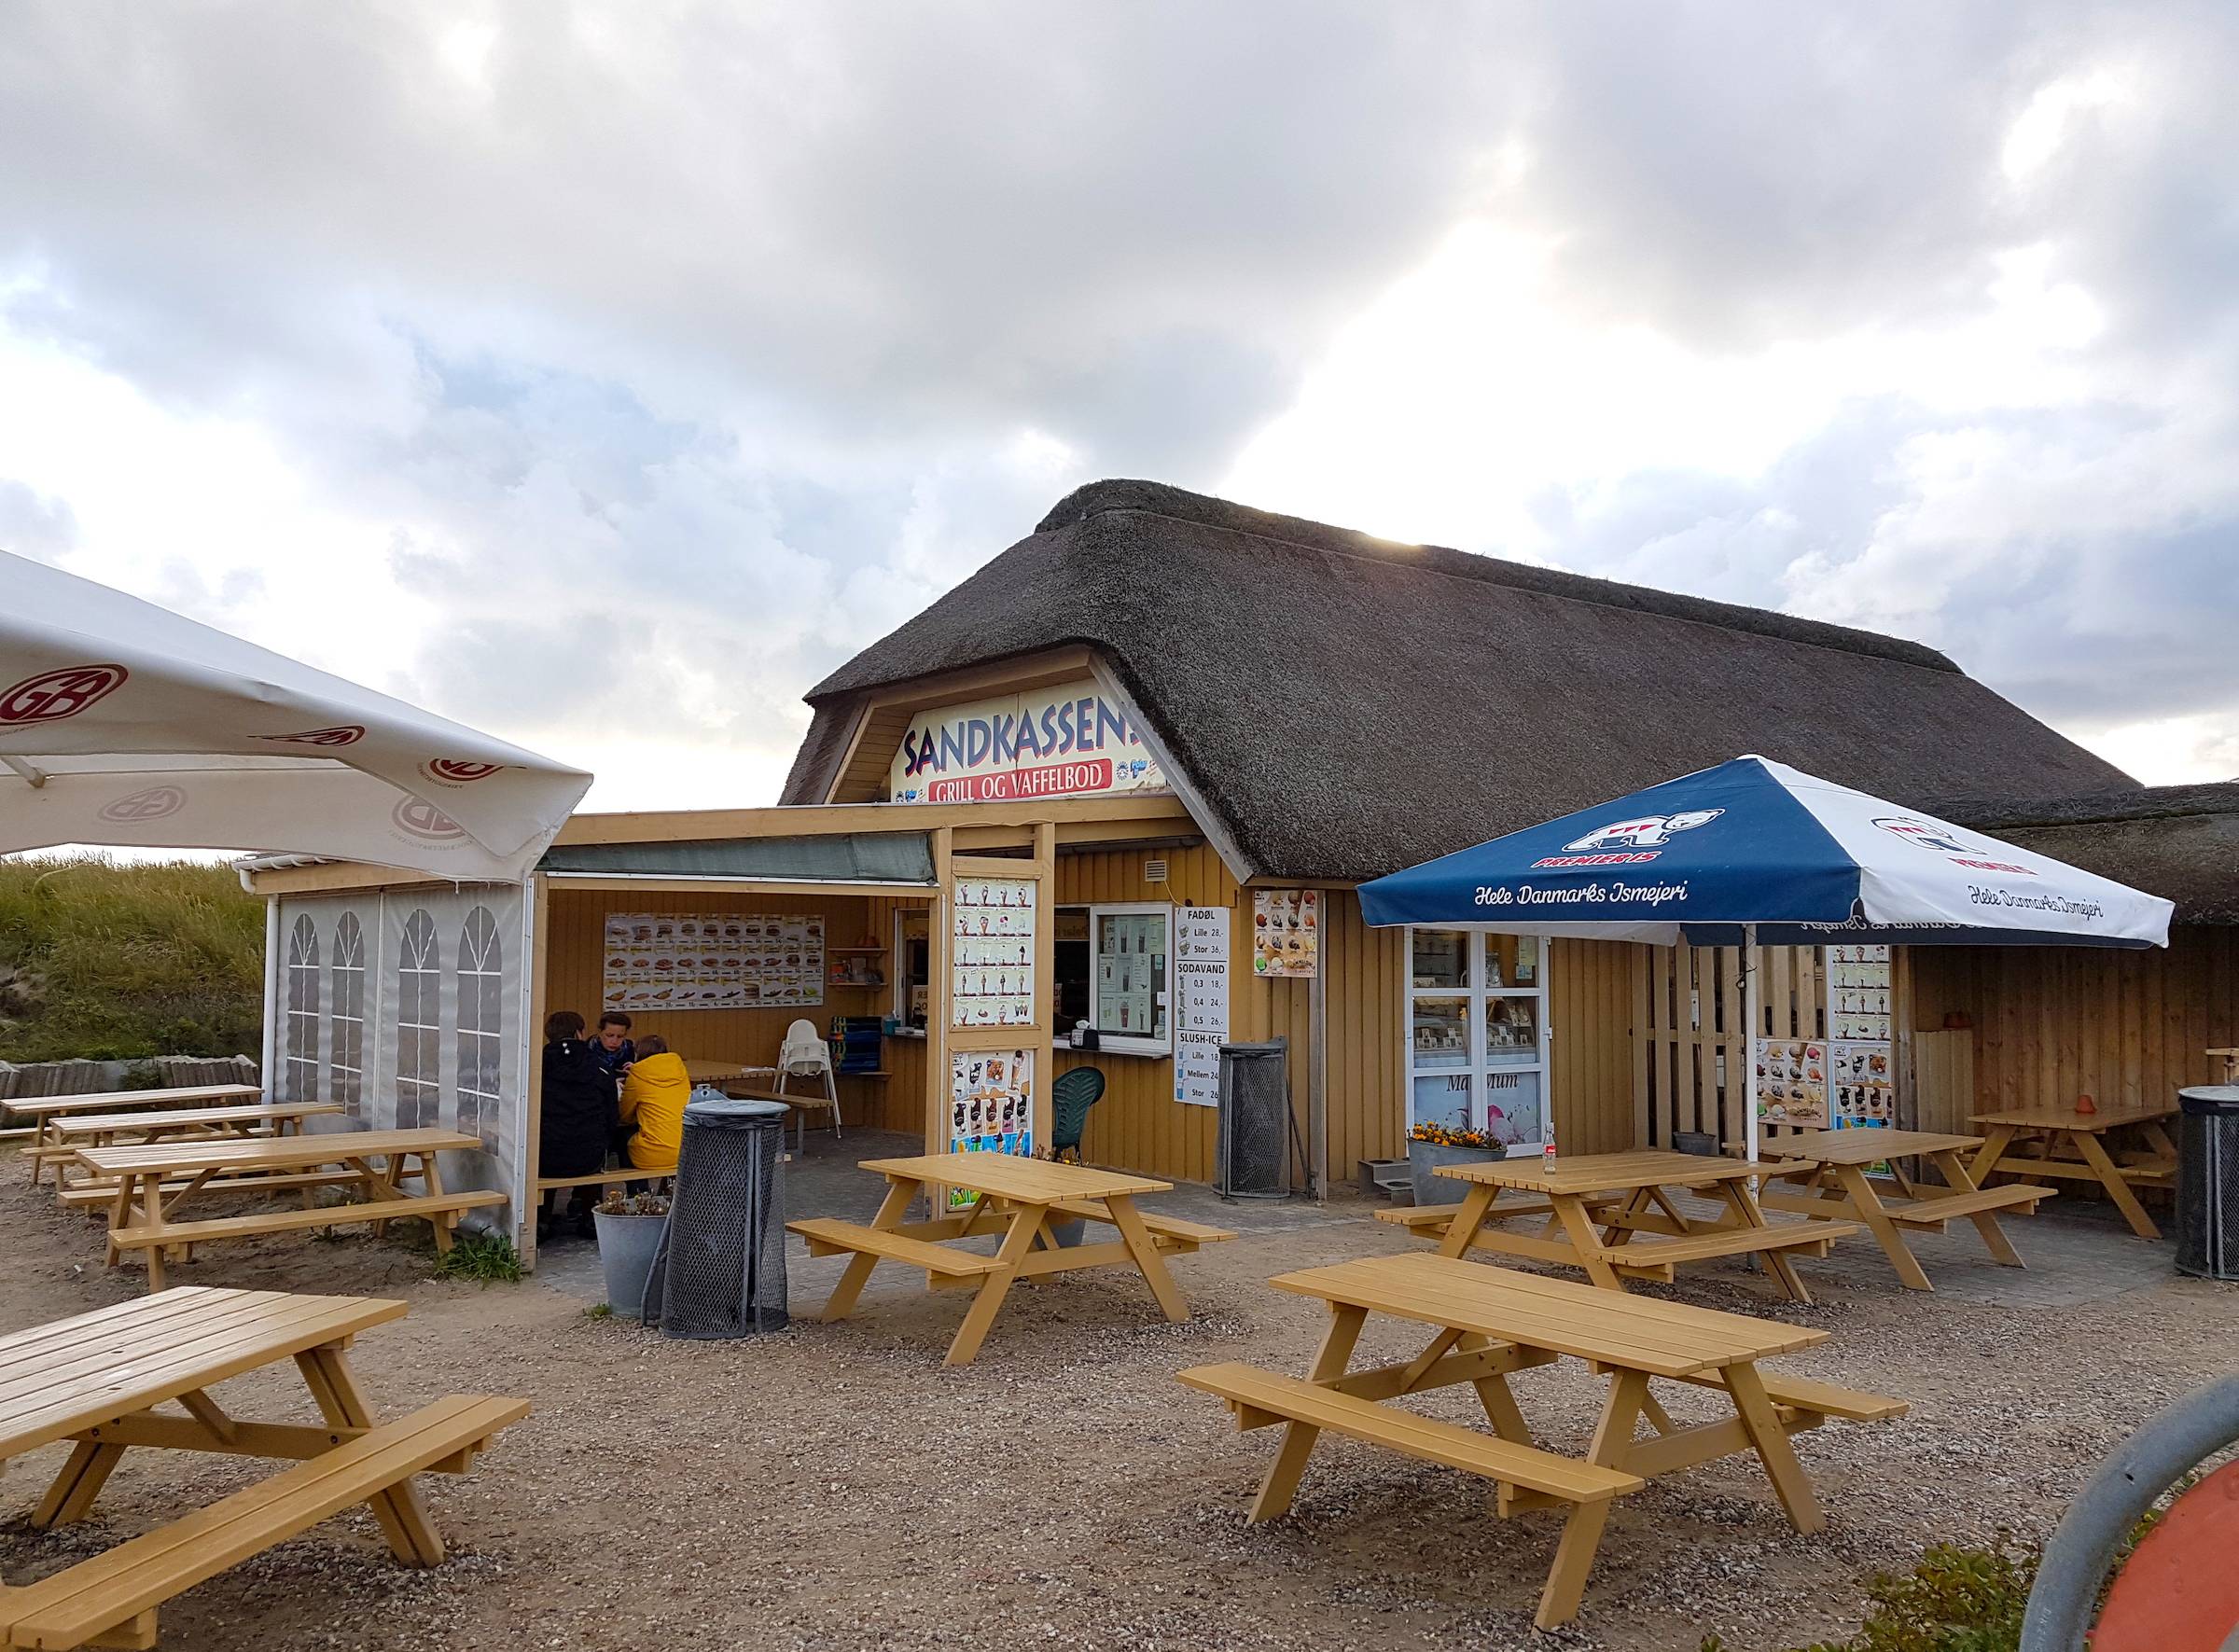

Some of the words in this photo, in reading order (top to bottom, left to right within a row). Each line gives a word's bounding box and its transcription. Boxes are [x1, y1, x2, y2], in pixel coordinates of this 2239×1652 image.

[905, 695, 1139, 778] SANDKASSEN
[936, 779, 974, 801] GRILL
[981, 774, 1006, 798] OG
[1011, 763, 1103, 798] VAFFELBOD
[1474, 885, 1513, 906] Hele
[1516, 883, 1606, 905] Danmarks
[1609, 880, 1689, 907] Ismejeri
[1968, 884, 2002, 906] Hele
[1999, 889, 2061, 912] Danmarks
[2057, 896, 2105, 921] Ismejeri
[1188, 910, 1216, 920] FADØL
[1194, 928, 1208, 937] Lille
[1177, 964, 1225, 974] SODAVAND
[1194, 980, 1203, 989] 0,3
[1194, 998, 1203, 1006] 0,4
[1194, 1016, 1203, 1024] 0,5
[1180, 1033, 1222, 1045] SLUSH-ICE
[1192, 1052, 1204, 1061] Lille
[1211, 1052, 1219, 1062] 18
[1187, 1069, 1210, 1079] Mellem
[1210, 1071, 1218, 1080] 24
[1191, 1089, 1204, 1097] Stor
[1210, 1090, 1219, 1099] 26
